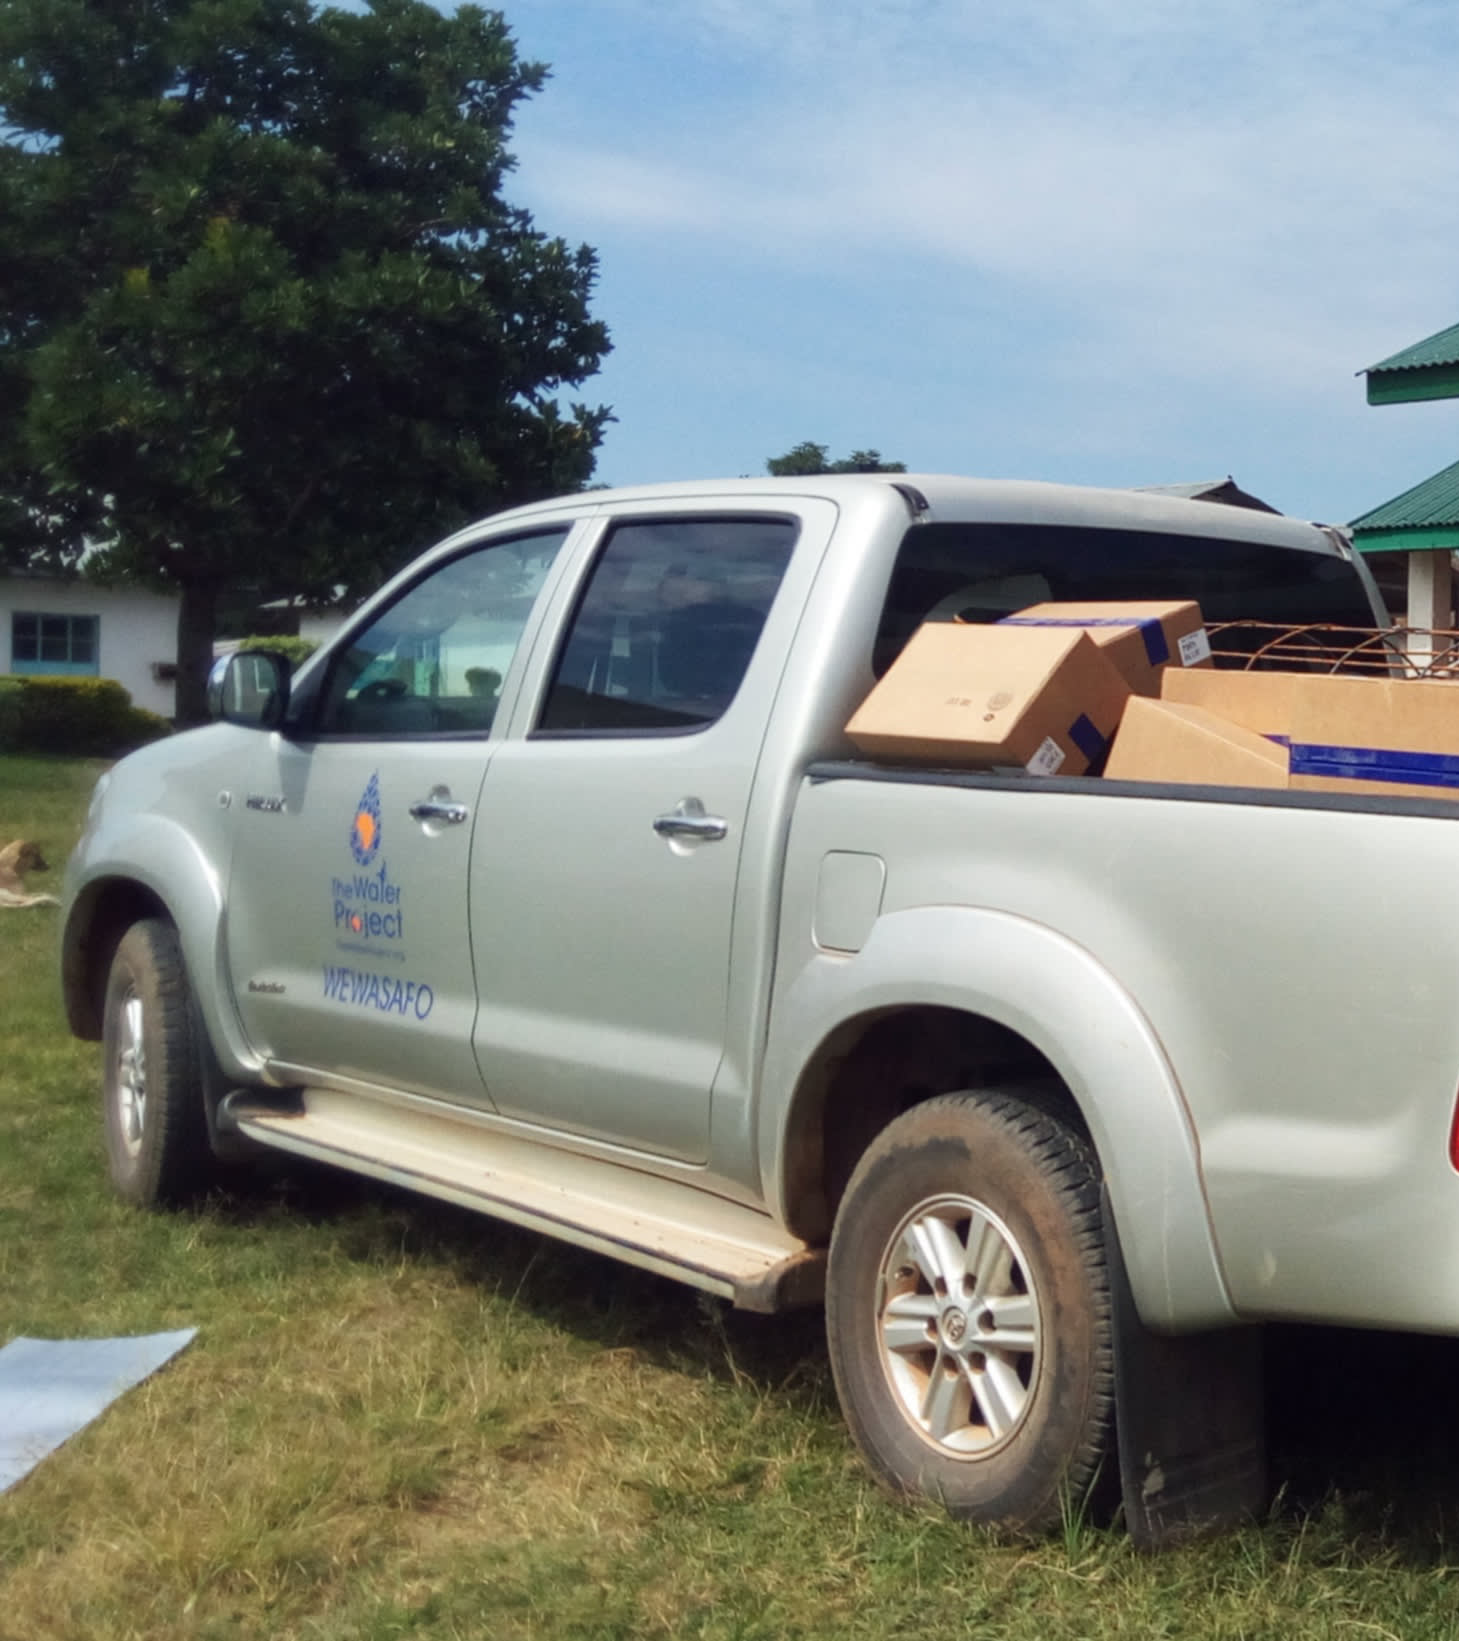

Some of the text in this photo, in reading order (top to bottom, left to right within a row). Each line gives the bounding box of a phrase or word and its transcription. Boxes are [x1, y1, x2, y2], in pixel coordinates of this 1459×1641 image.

[353, 859, 401, 905] Water
[334, 899, 403, 939] Project
[322, 964, 434, 1020] WEWASAFO
